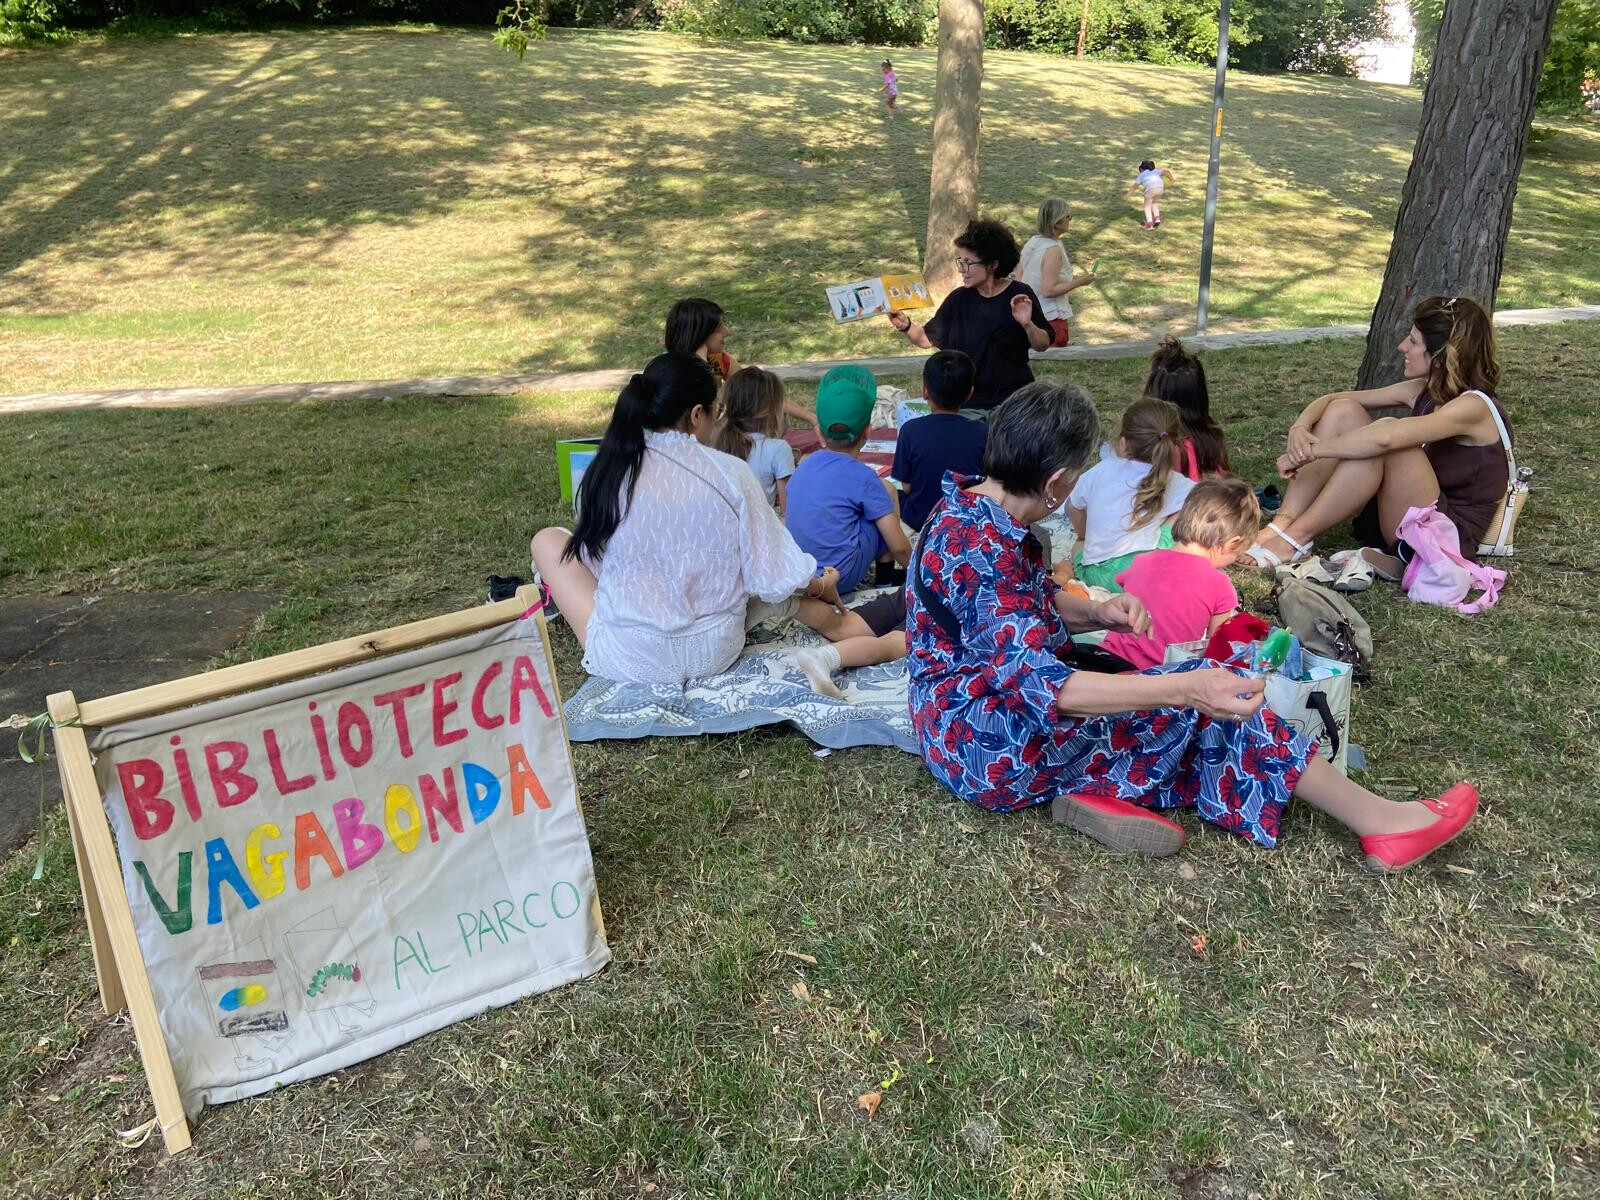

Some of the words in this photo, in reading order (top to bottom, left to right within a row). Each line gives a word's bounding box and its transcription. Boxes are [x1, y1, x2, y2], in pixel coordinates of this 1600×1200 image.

[133, 744, 551, 935] VAGABONDA
[393, 932, 451, 989] AL
[457, 881, 581, 957] PARCO
